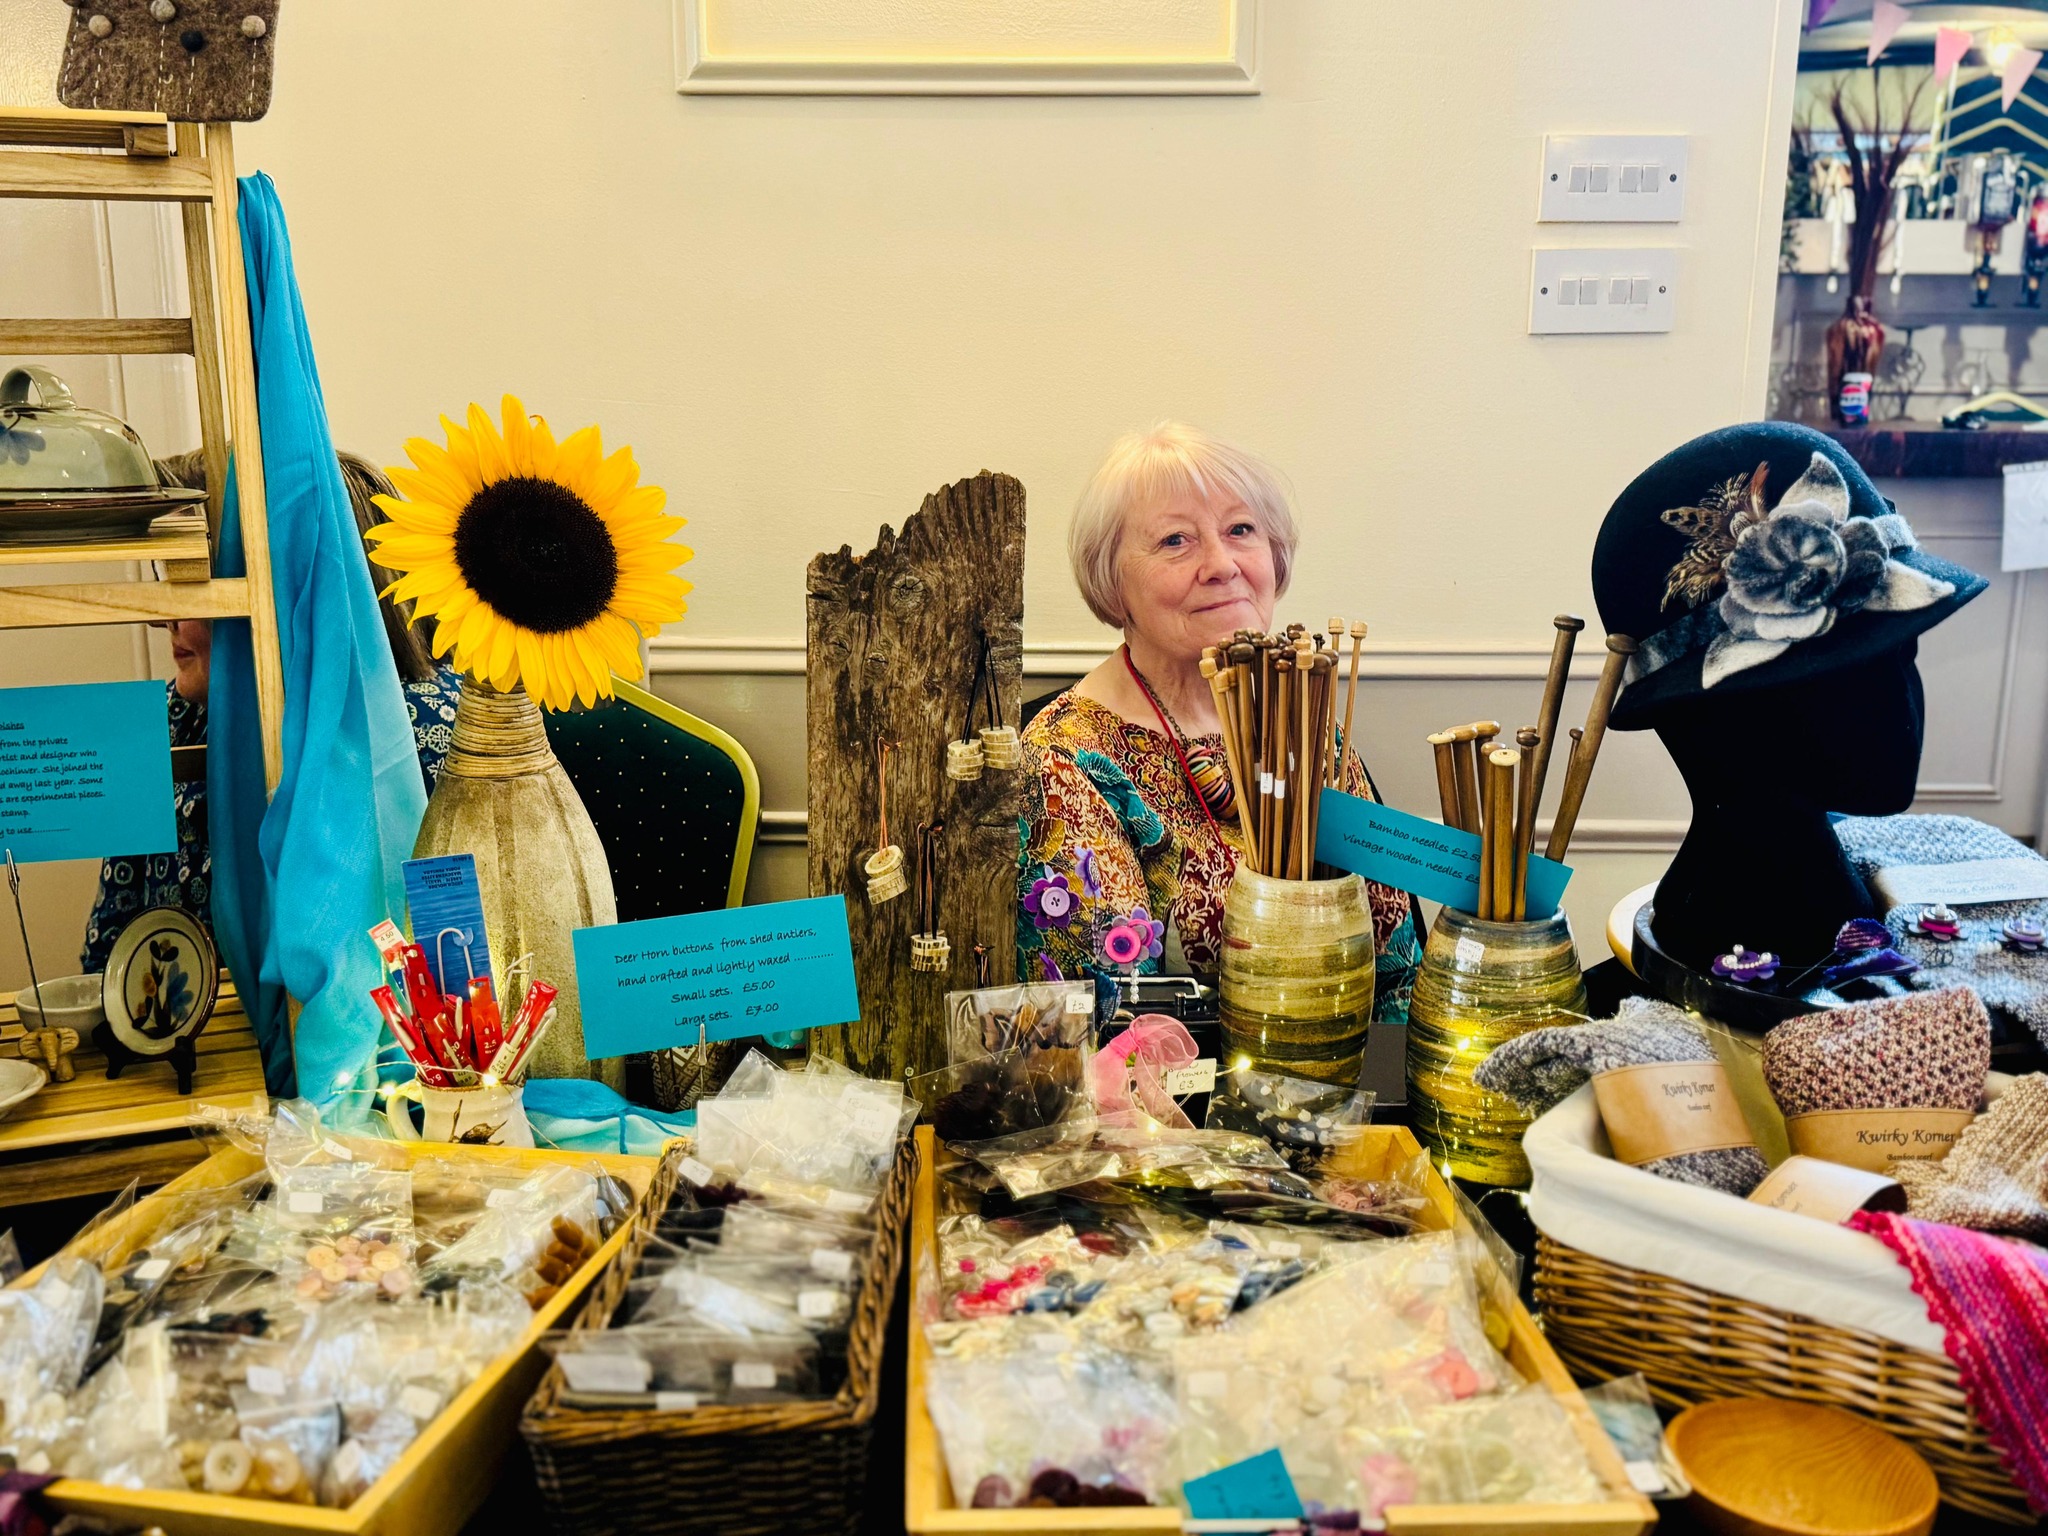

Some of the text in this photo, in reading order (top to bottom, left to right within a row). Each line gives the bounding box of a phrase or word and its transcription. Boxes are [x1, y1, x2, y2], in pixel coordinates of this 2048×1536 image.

[0, 738, 68, 750] from the private
[20, 752, 37, 760] and
[40, 751, 77, 760] designer
[80, 749, 97, 757] who
[42, 764, 59, 773] She
[61, 763, 87, 774] joined
[90, 762, 103, 770] the
[8, 781, 32, 791] away
[54, 779, 76, 789] year.
[21, 791, 76, 804] experimental
[78, 790, 105, 801] pieces.
[1367, 819, 1410, 840] Bamboo
[1411, 836, 1449, 853] needles
[1343, 833, 1384, 853] Vintage
[1386, 848, 1423, 866] wooden
[1425, 862, 1463, 879] needles
[614, 928, 817, 964] Deer Horn buttons from shed antlers,
[617, 973, 647, 987] hand
[649, 968, 689, 983] crafted
[691, 964, 713, 976] and
[716, 959, 755, 975] lightly
[758, 952, 790, 966] waxed
[671, 980, 775, 1003] Small sets. £5.00
[674, 1002, 779, 1027] Large sets. £7.00
[1856, 1128, 1956, 1146] Kwirky Korner
[1886, 1152, 1933, 1161] Bamboo scarf
